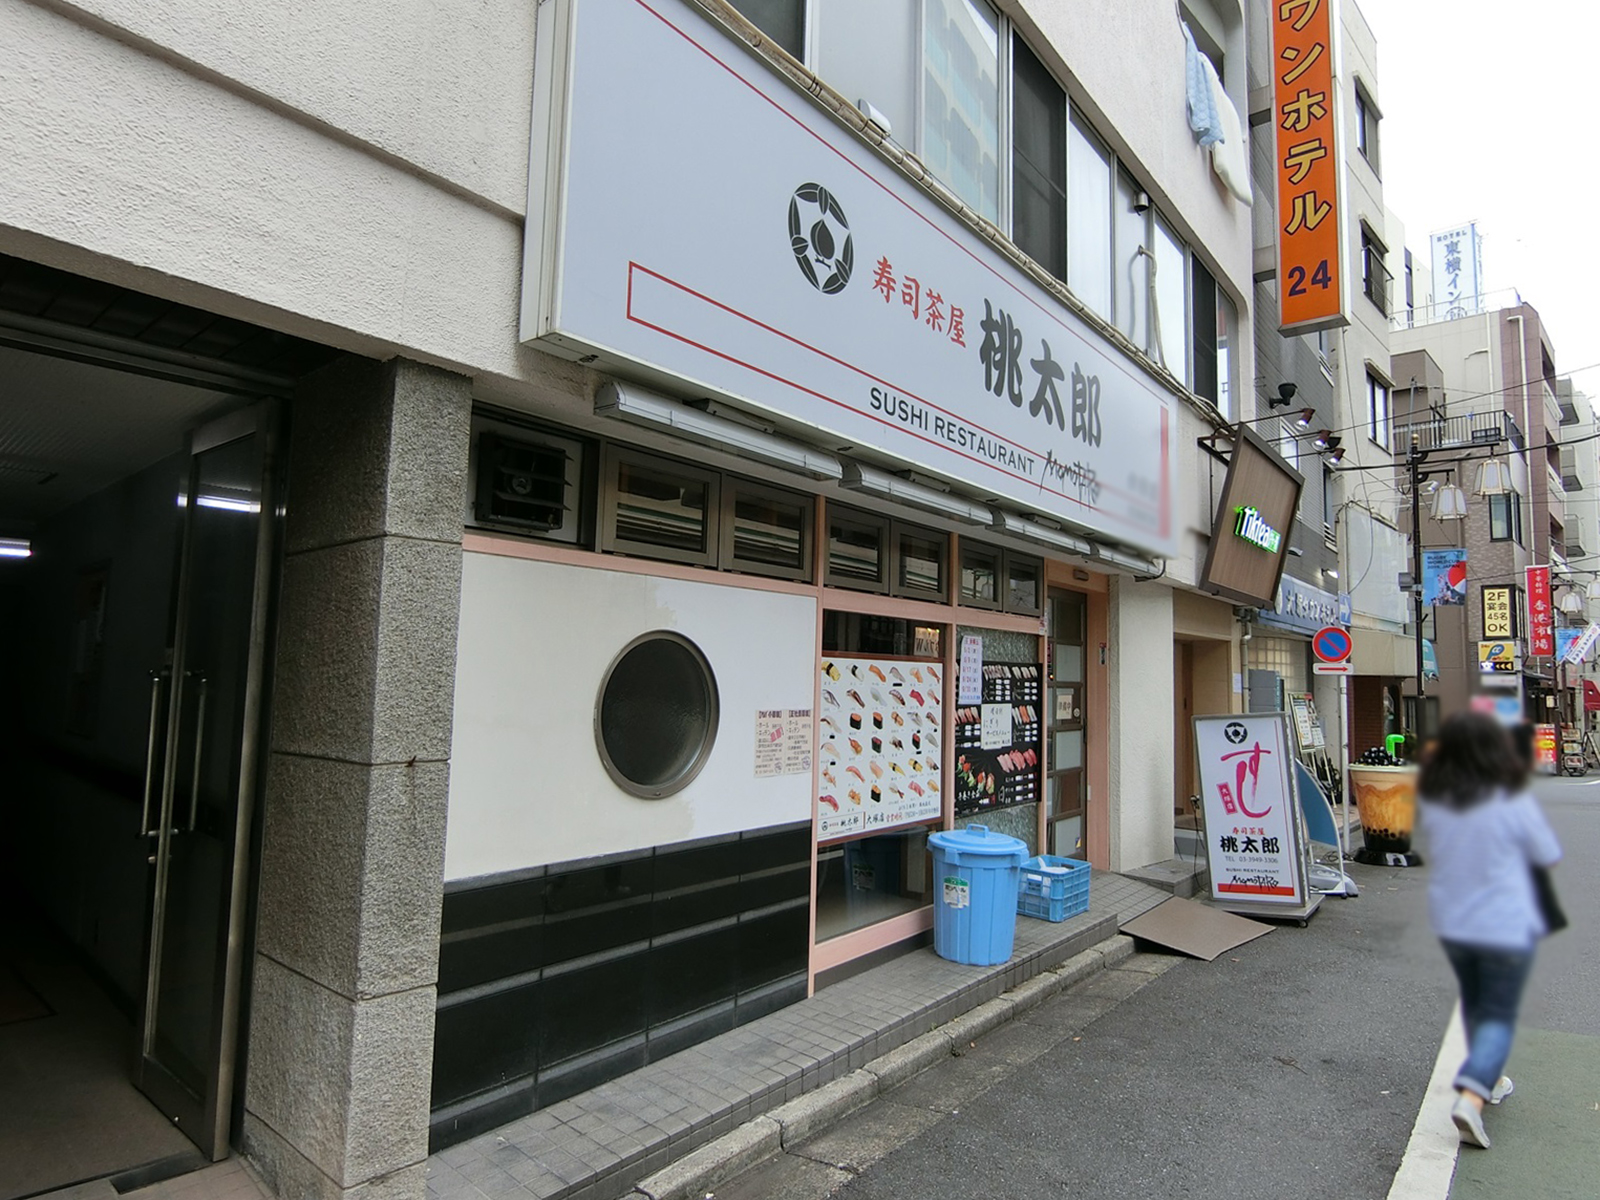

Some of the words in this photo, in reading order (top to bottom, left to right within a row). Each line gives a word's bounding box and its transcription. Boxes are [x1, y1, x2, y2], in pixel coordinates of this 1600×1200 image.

[1279, 0, 1332, 236] ウンホテル
[1287, 259, 1332, 297] 24
[1444, 240, 1462, 306] 東横イン
[872, 255, 967, 349] 寿司茶屋
[979, 298, 1102, 448] 桃太郎
[869, 387, 929, 431] SUSHI
[934, 416, 1035, 476] RESTAURANT
[1487, 591, 1507, 601] 2F
[1487, 602, 1508, 611] 宴会
[1487, 612, 1508, 621] 45名
[1487, 623, 1508, 633] OK
[1232, 826, 1265, 835] 寿司茶屋
[1219, 835, 1280, 854] 桃太郎
[1225, 855, 1236, 863] TEL
[1238, 855, 1279, 864] 03-3949-3306
